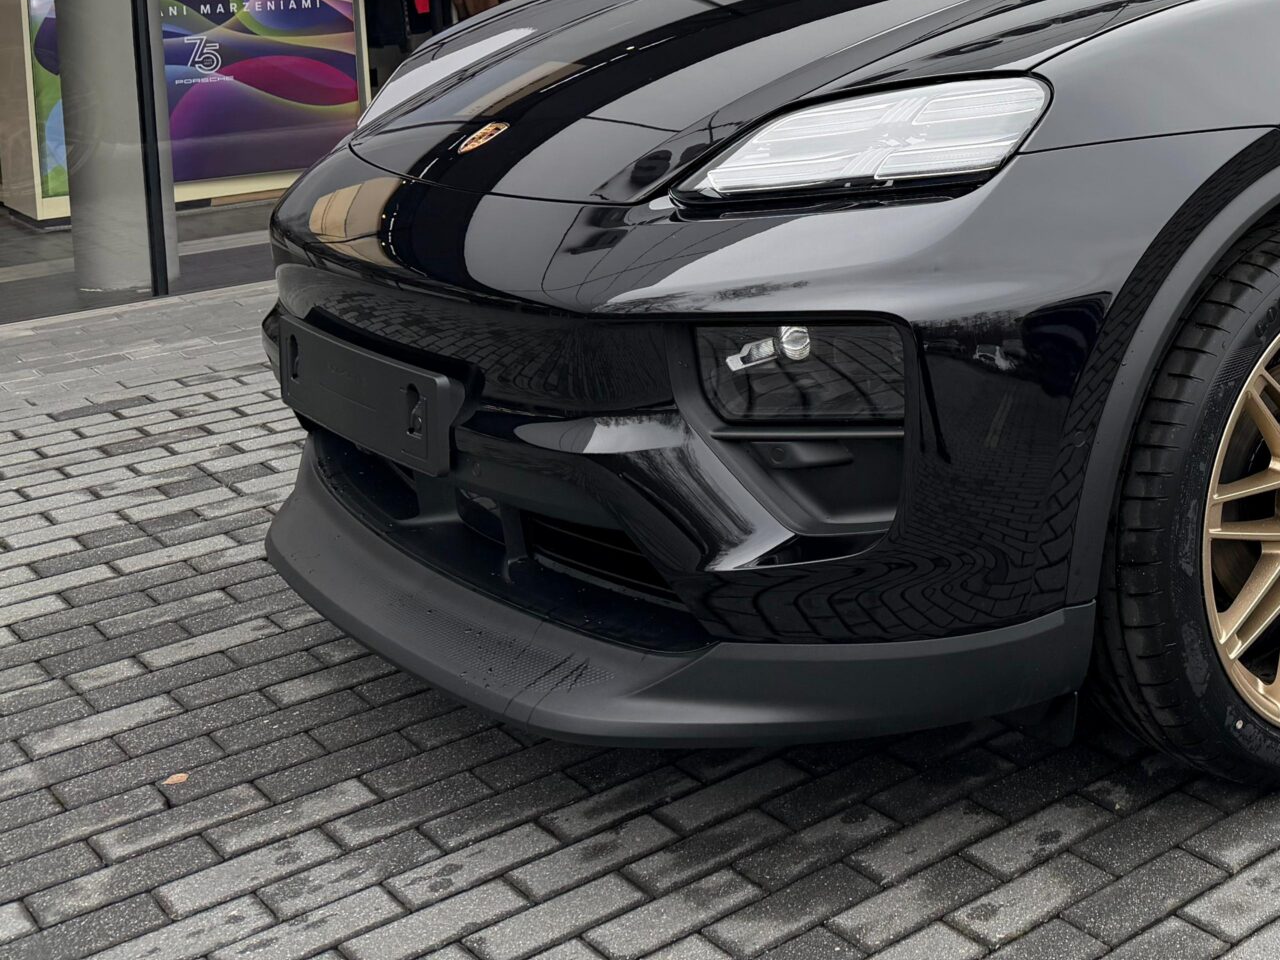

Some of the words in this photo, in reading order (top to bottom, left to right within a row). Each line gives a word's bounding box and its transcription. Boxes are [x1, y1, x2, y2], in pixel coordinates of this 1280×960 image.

[160, 5, 187, 17] NI
[184, 36, 222, 74] 75
[175, 75, 235, 85] PORSCHE
